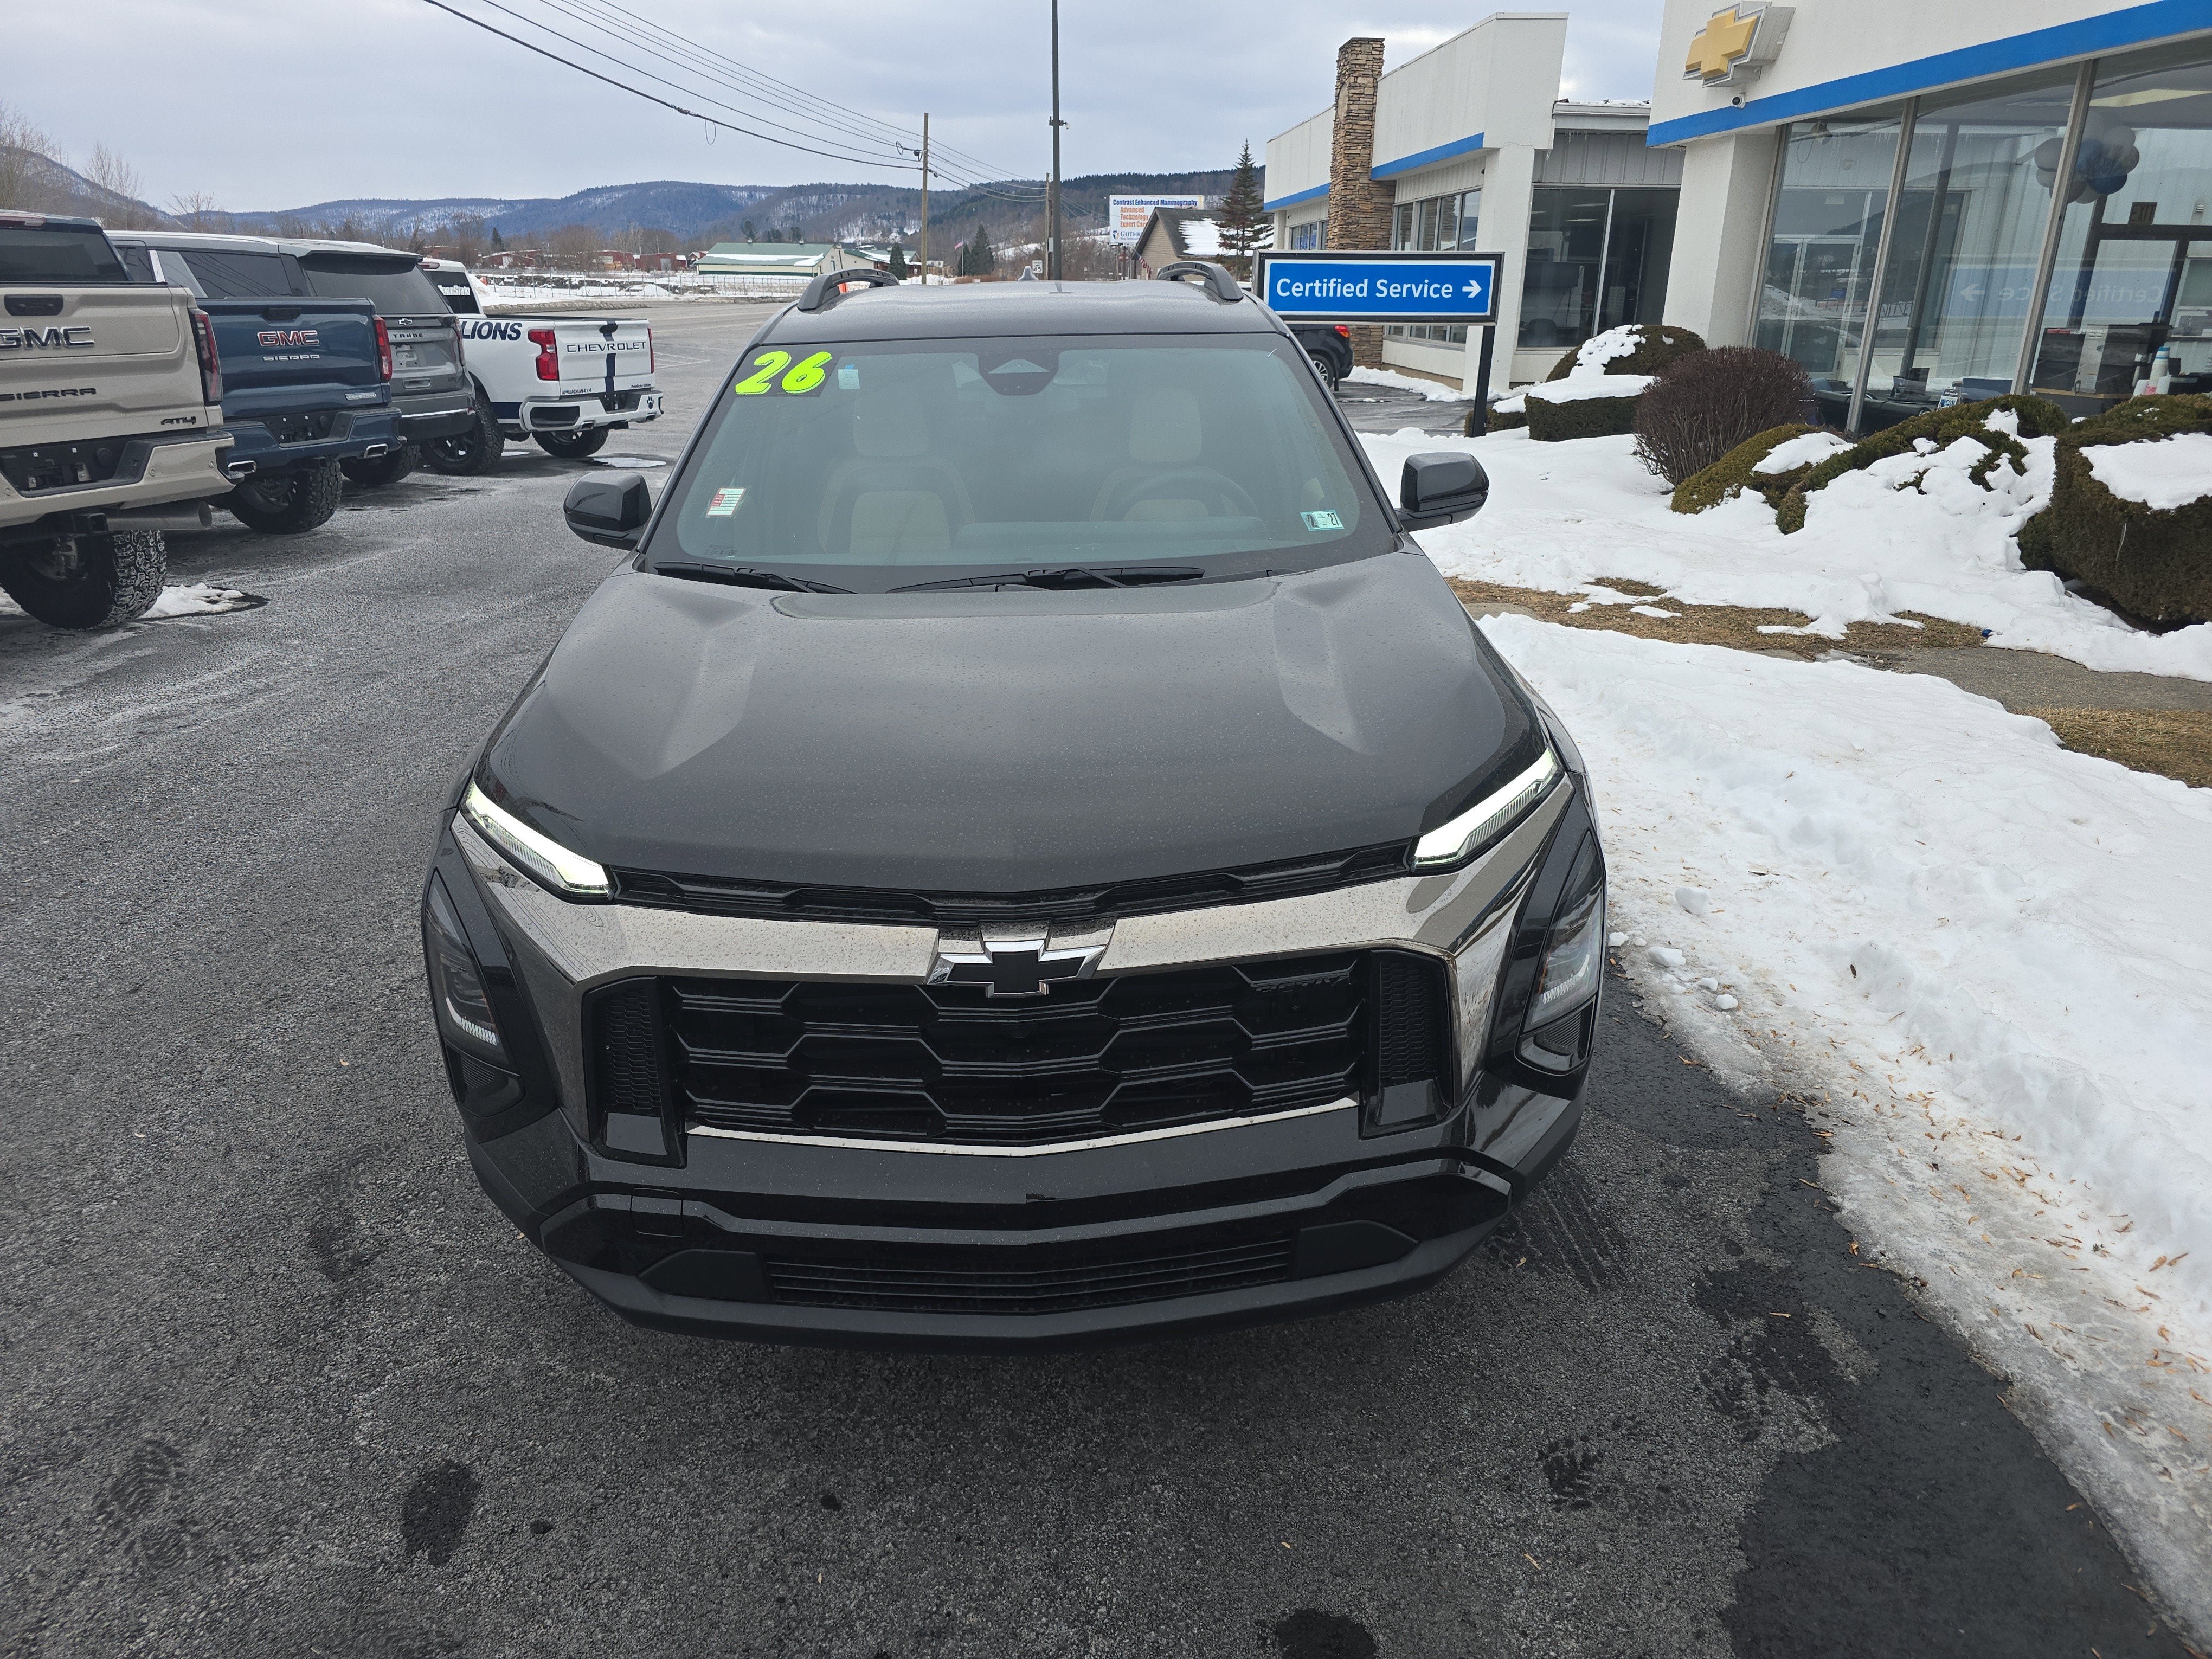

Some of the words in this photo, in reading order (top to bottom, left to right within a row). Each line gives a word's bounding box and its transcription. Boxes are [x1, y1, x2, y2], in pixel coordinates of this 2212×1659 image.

[1276, 278, 1368, 298] Certified
[1375, 279, 1453, 298] Service
[0, 326, 95, 350] GMC
[257, 330, 320, 346] GMC
[461, 321, 523, 340] LIONS
[567, 342, 646, 352] CHEVROLET
[735, 351, 833, 395] 26
[0, 388, 97, 401] SIERRA
[160, 416, 196, 425] AT4
[1327, 513, 1339, 526] 27
